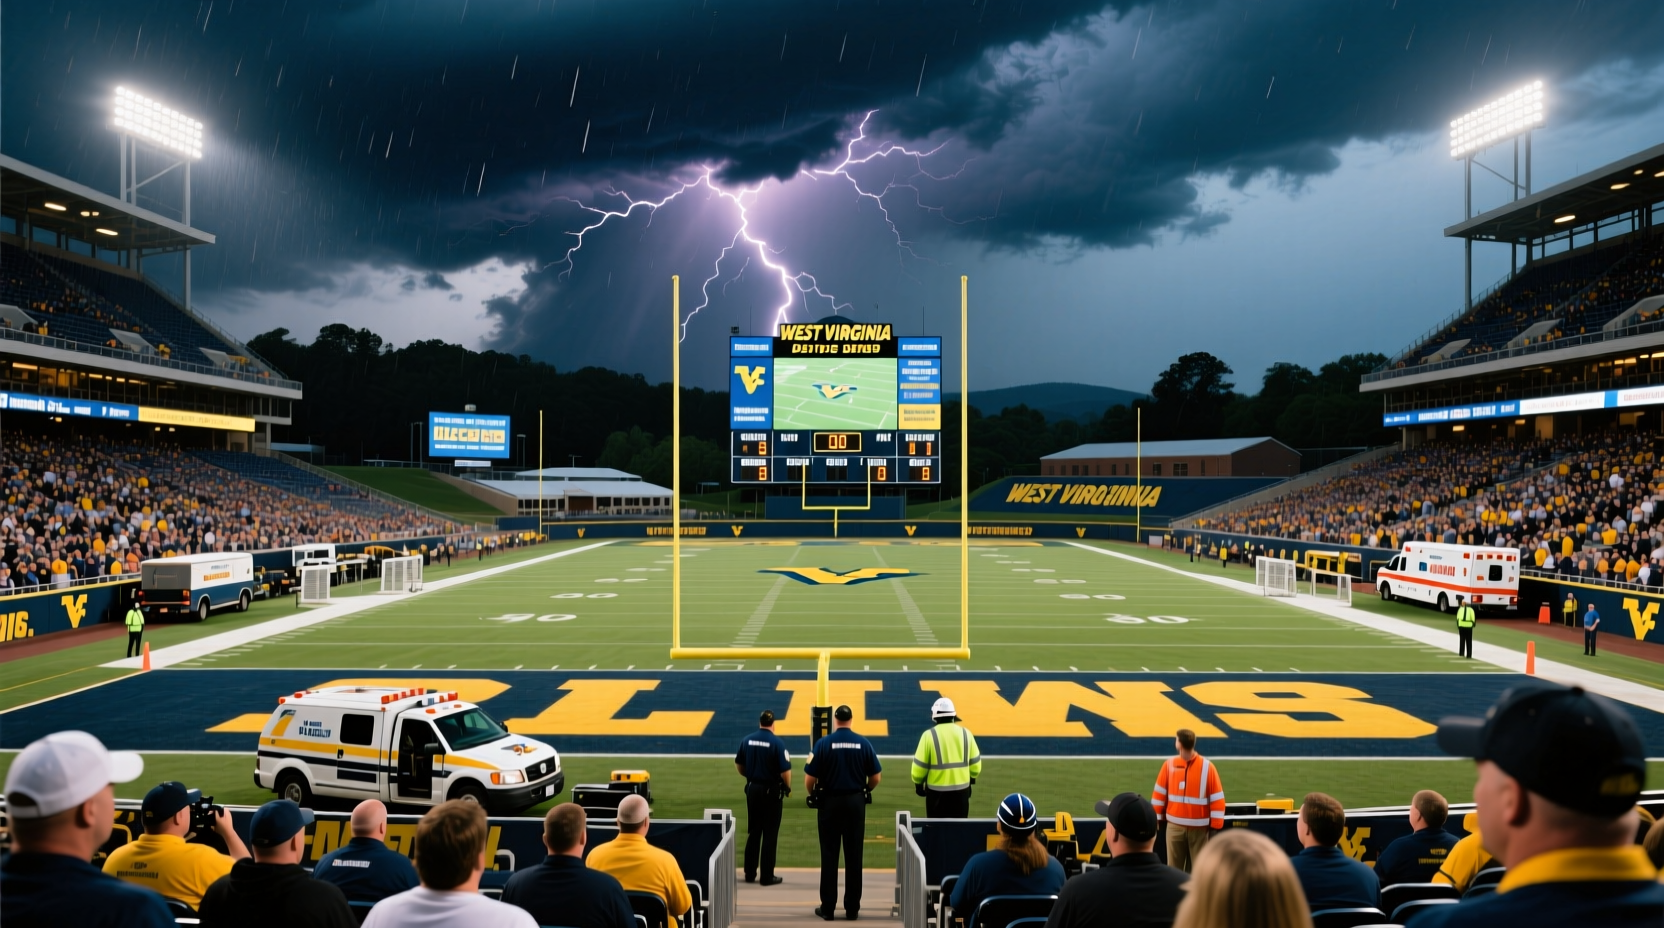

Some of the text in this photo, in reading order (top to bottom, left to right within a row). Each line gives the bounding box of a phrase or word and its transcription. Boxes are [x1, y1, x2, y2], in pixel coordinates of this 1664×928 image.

[780, 324, 891, 341] WEST VIRGINIA
[1006, 483, 1063, 504] WEST
